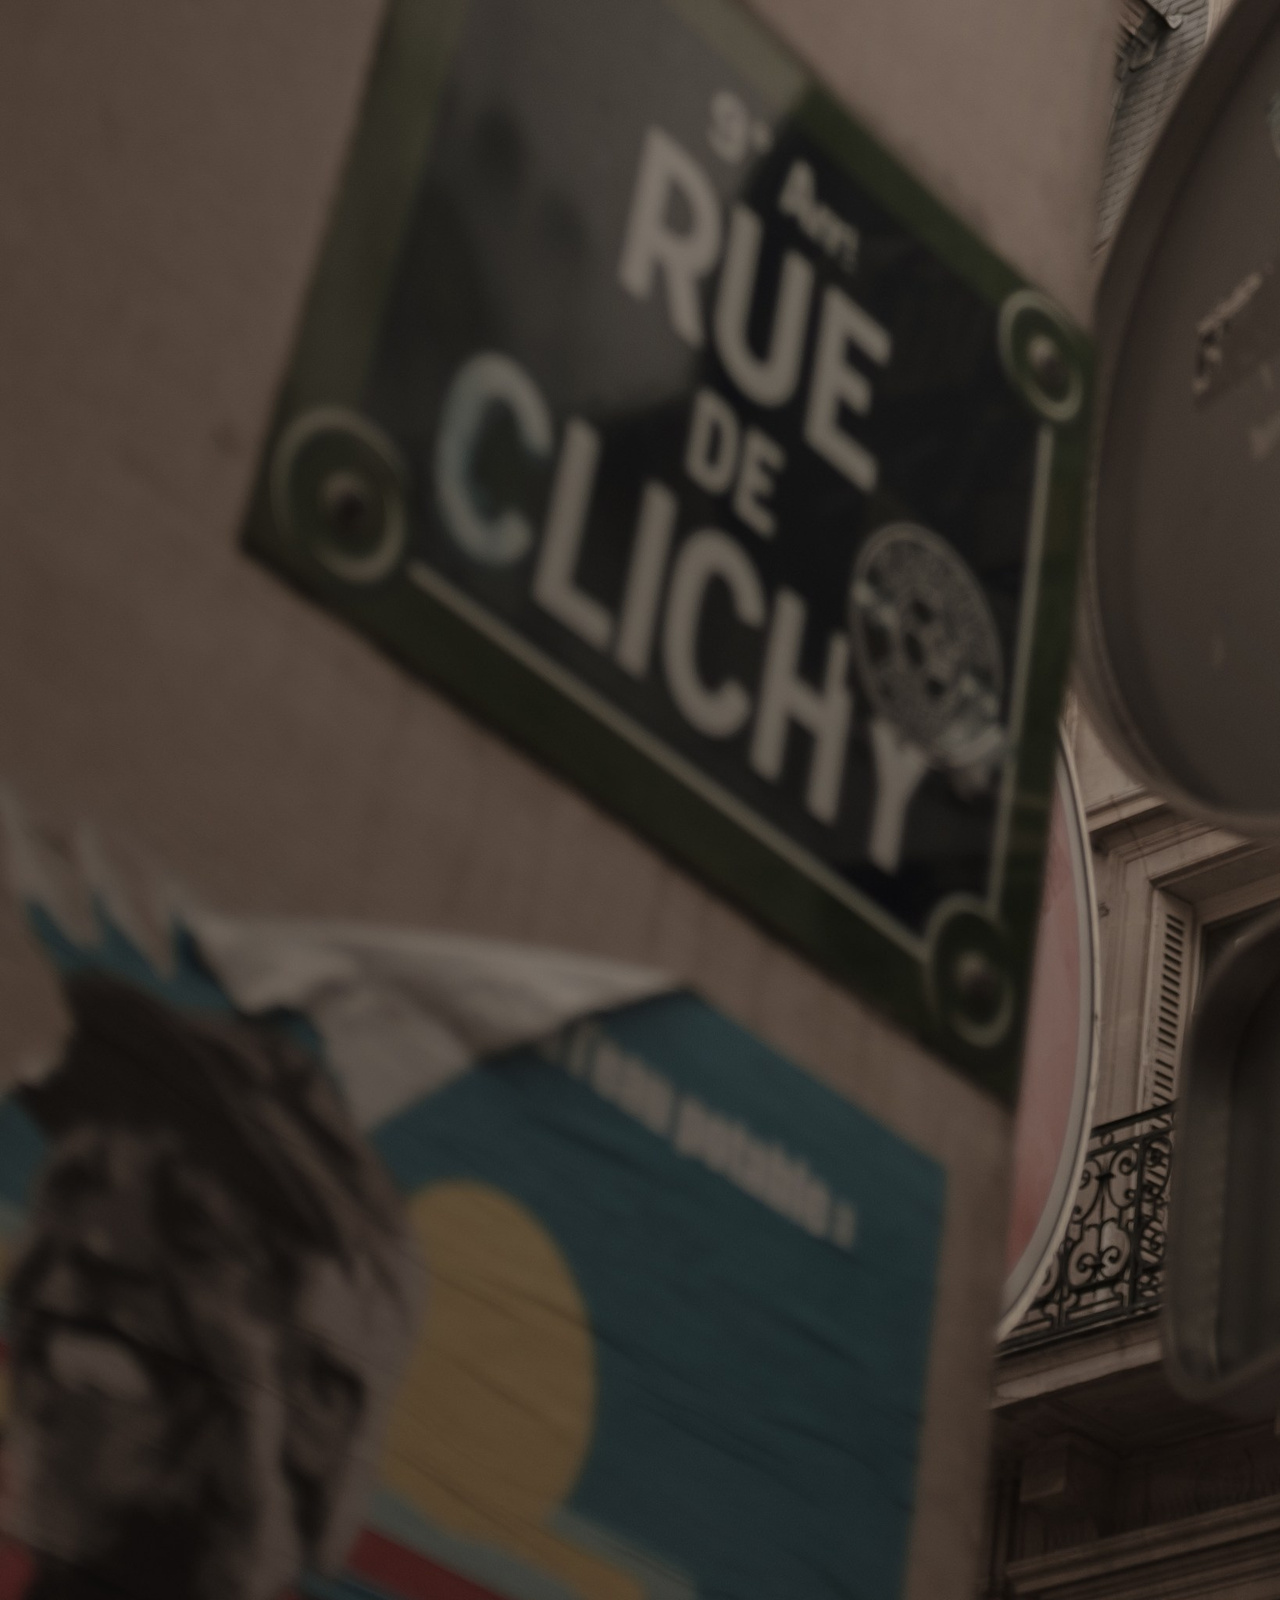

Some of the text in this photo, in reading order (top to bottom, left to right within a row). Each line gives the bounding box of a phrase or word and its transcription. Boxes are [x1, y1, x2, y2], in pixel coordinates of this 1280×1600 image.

[618, 122, 895, 496] RUE
[684, 387, 786, 541] DE
[433, 349, 932, 877] CLICHY
